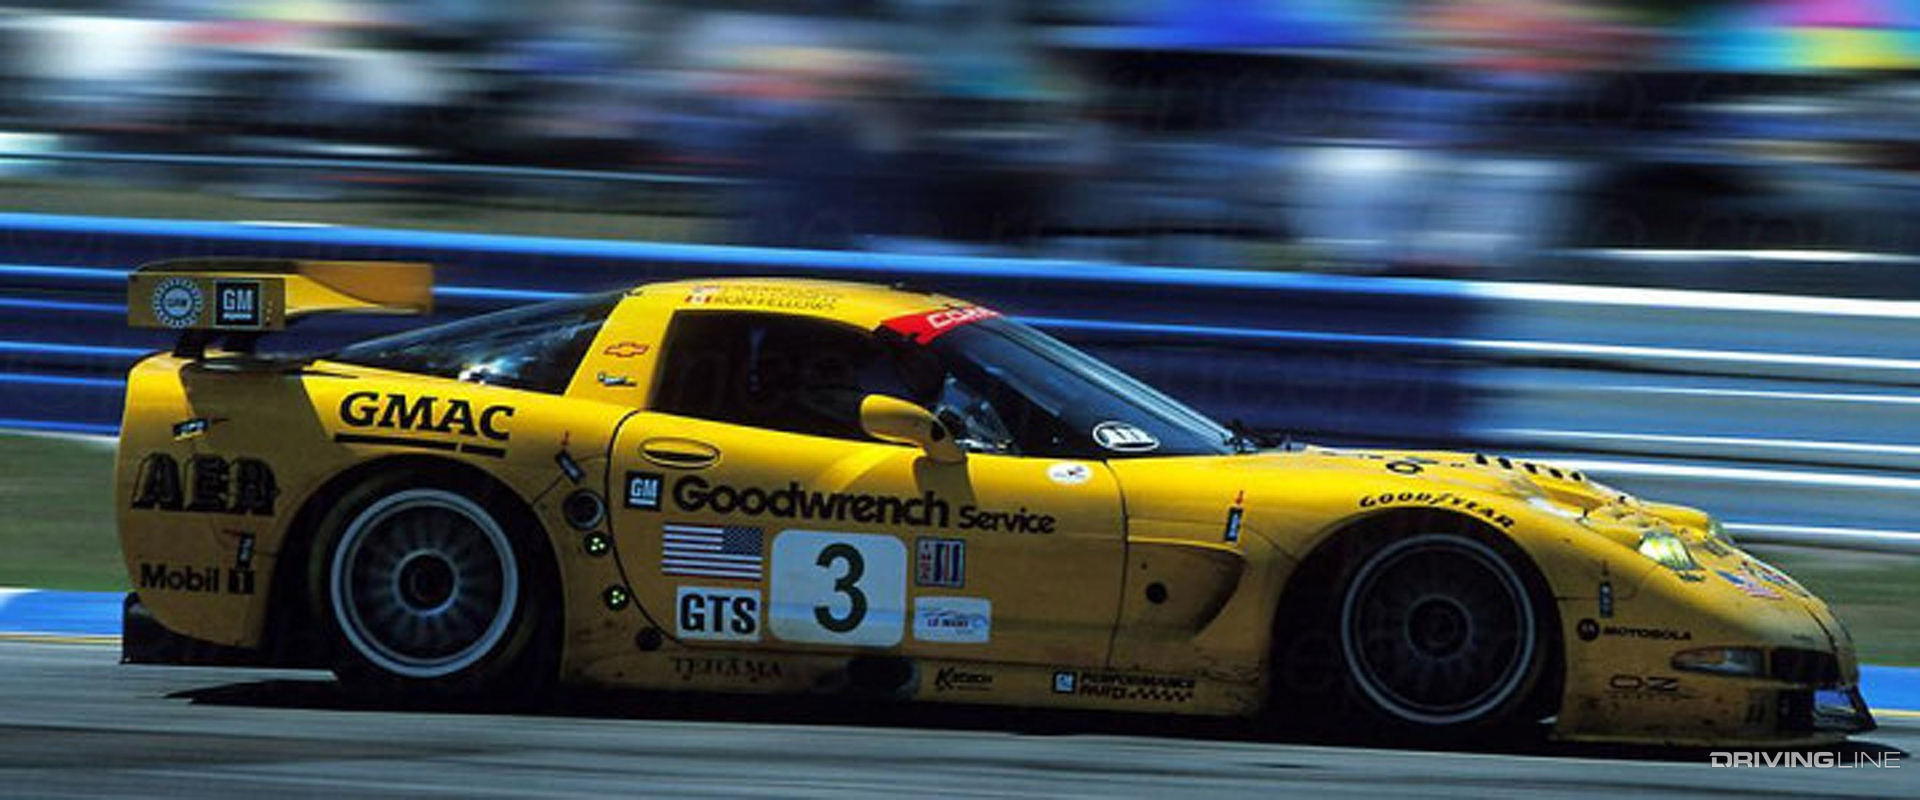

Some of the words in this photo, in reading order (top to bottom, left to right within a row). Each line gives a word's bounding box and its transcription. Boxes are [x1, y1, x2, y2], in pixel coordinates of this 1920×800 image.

[222, 288, 254, 311] GM
[340, 391, 515, 441] GMAC
[631, 477, 658, 498] GM
[672, 473, 949, 528] Goodwrench
[957, 505, 1056, 533] Service
[1359, 492, 1515, 529] GOODYEAR
[141, 563, 220, 592] Mobil
[813, 542, 869, 634] 3
[680, 594, 758, 635] GTS
[1604, 626, 1692, 640] MOTOROLA
